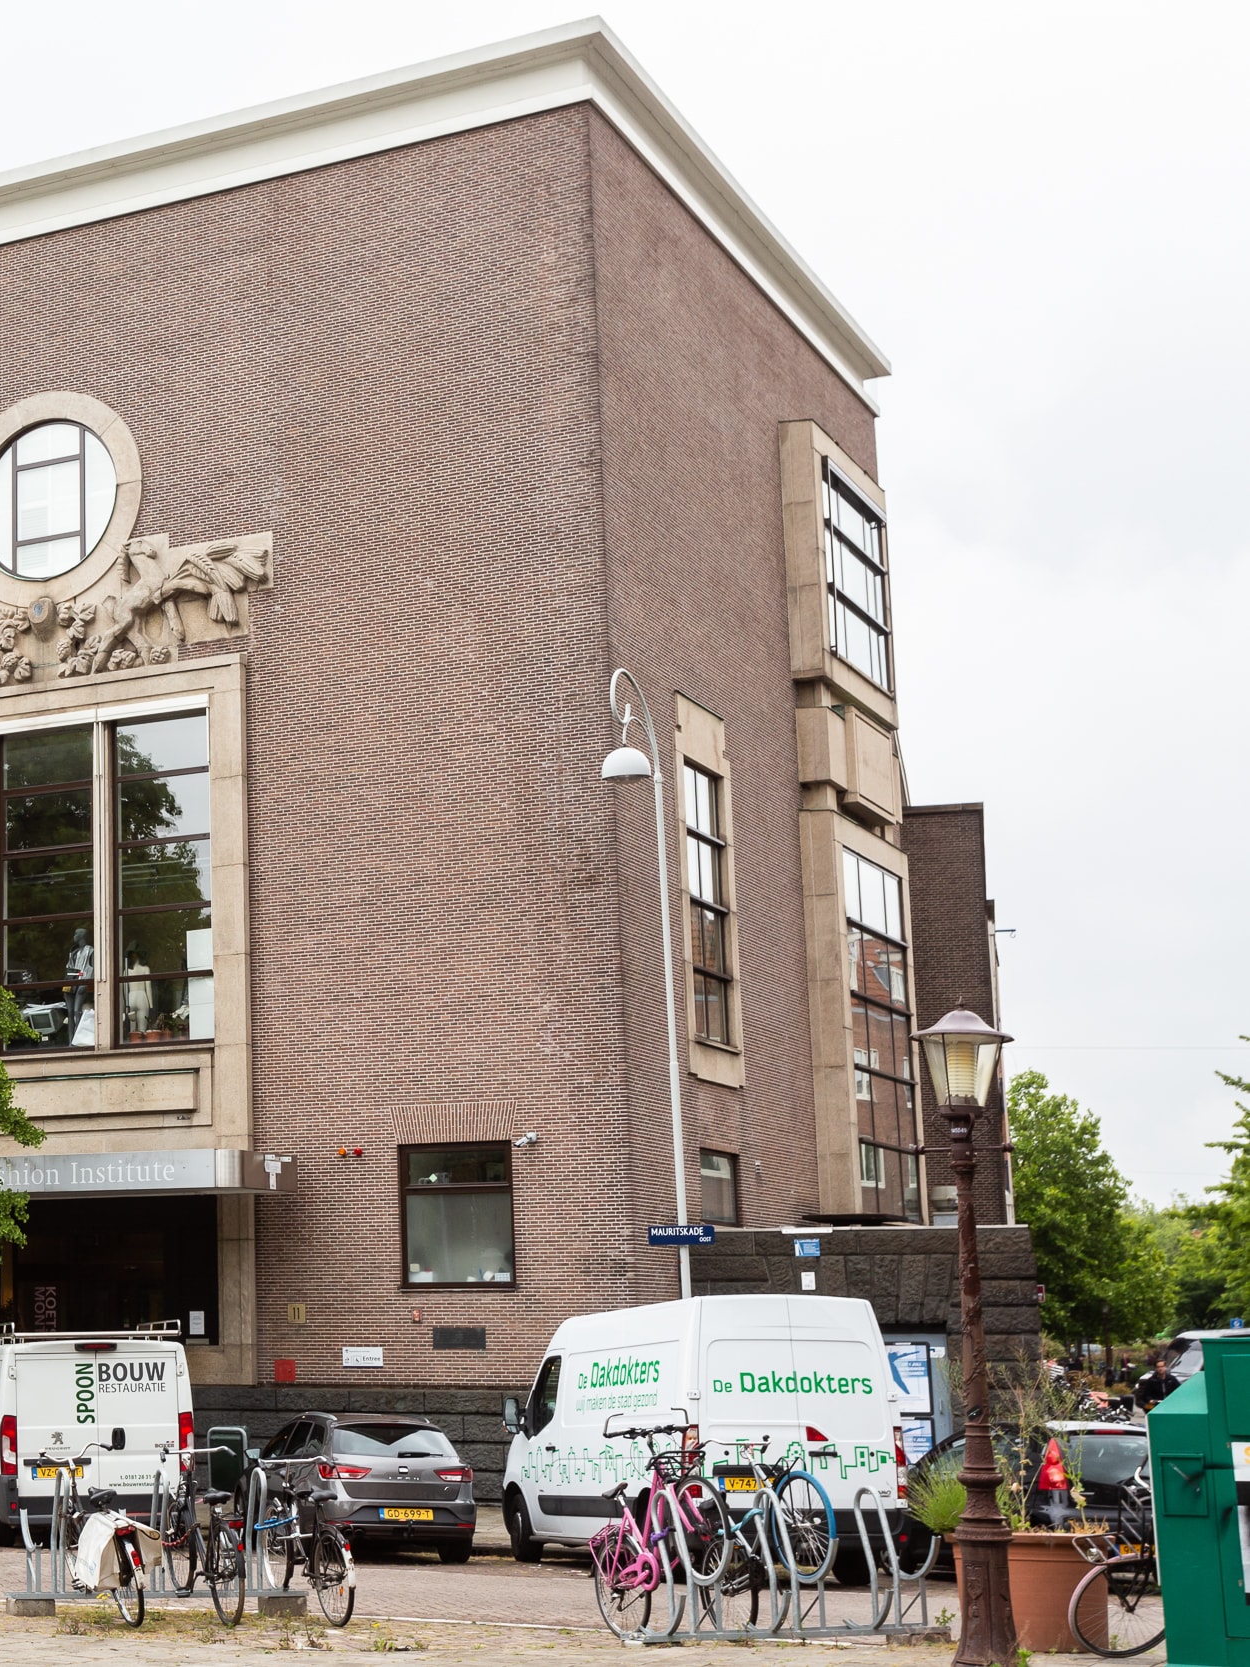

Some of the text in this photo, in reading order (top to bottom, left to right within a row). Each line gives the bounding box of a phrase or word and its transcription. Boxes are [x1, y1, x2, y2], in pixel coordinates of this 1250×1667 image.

[70, 1159, 175, 1184] Institute
[651, 1227, 704, 1236] MAURITSKADE
[292, 1307, 300, 1320] 11
[98, 1362, 166, 1382] BOUW
[578, 1355, 660, 1389] De Dakdokters
[98, 1382, 166, 1393] RESTAURATIE
[713, 1370, 873, 1395] De Dakdokters
[75, 1363, 95, 1424] SPOON
[728, 1479, 768, 1488] V-747
[387, 1509, 430, 1518] GD-699-T
